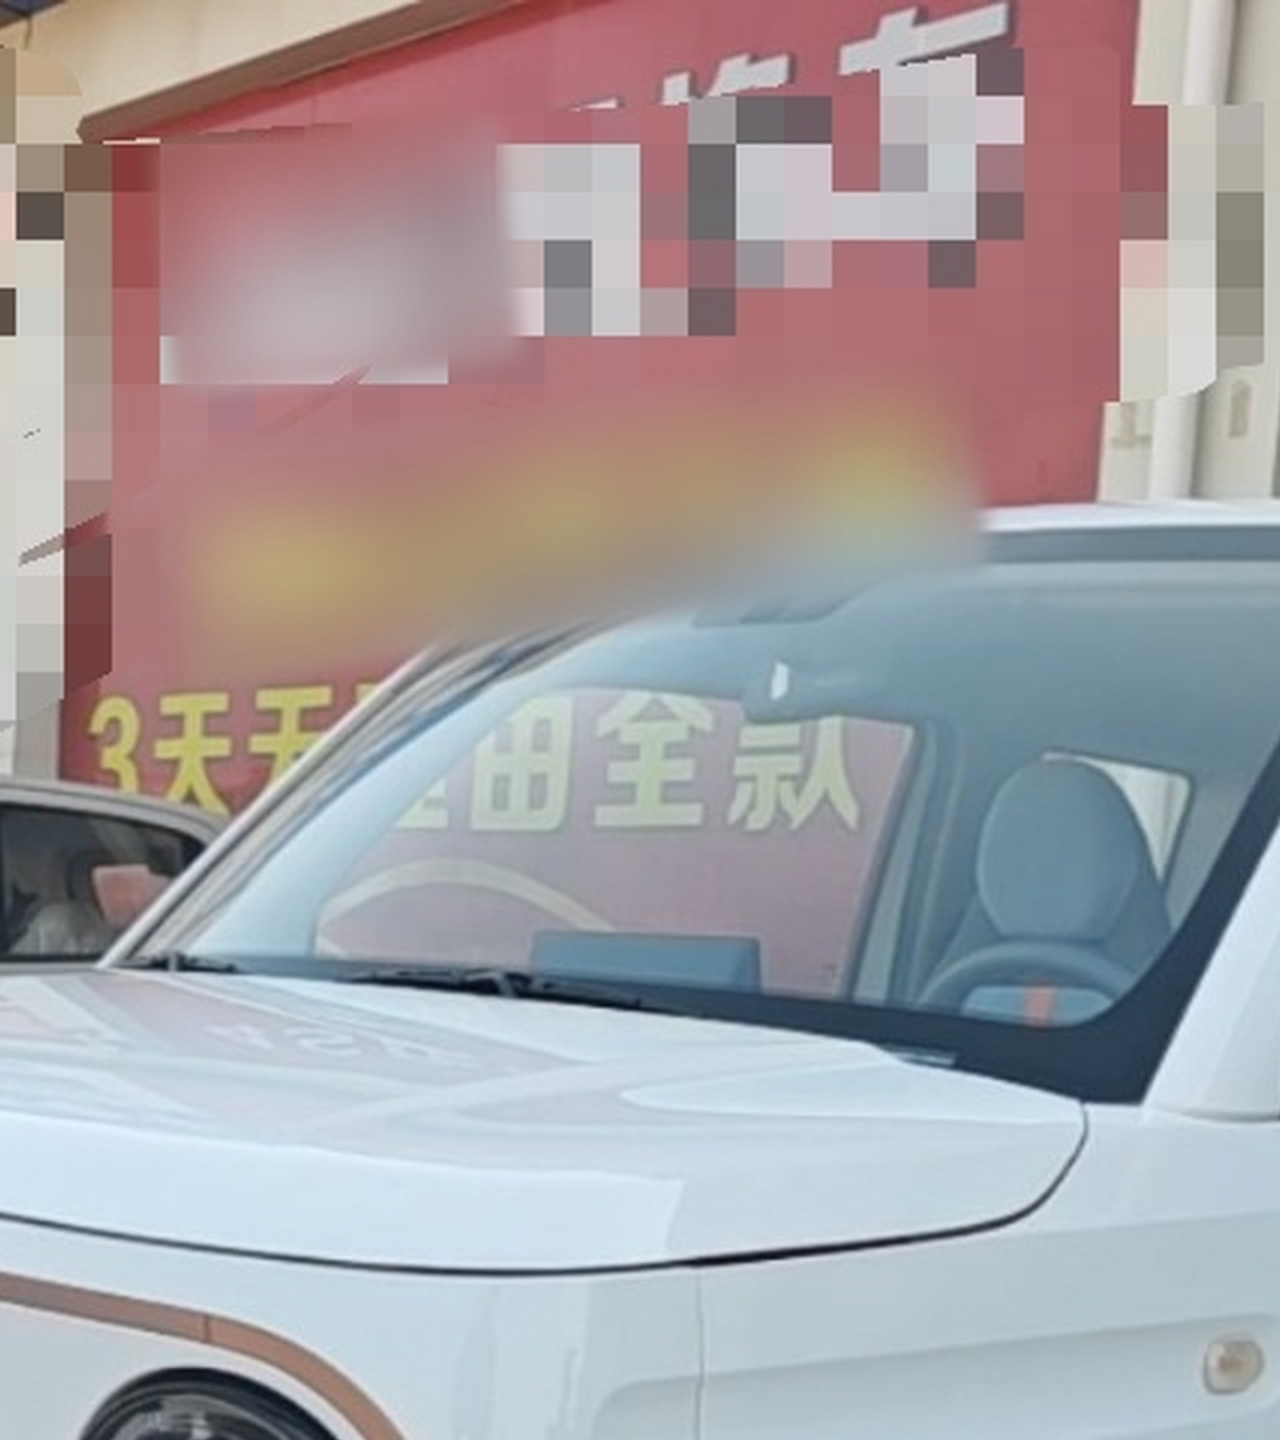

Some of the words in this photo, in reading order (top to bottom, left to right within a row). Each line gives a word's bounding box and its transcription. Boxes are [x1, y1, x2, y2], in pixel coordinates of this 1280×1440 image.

[88, 683, 859, 832] 3天无由全款
